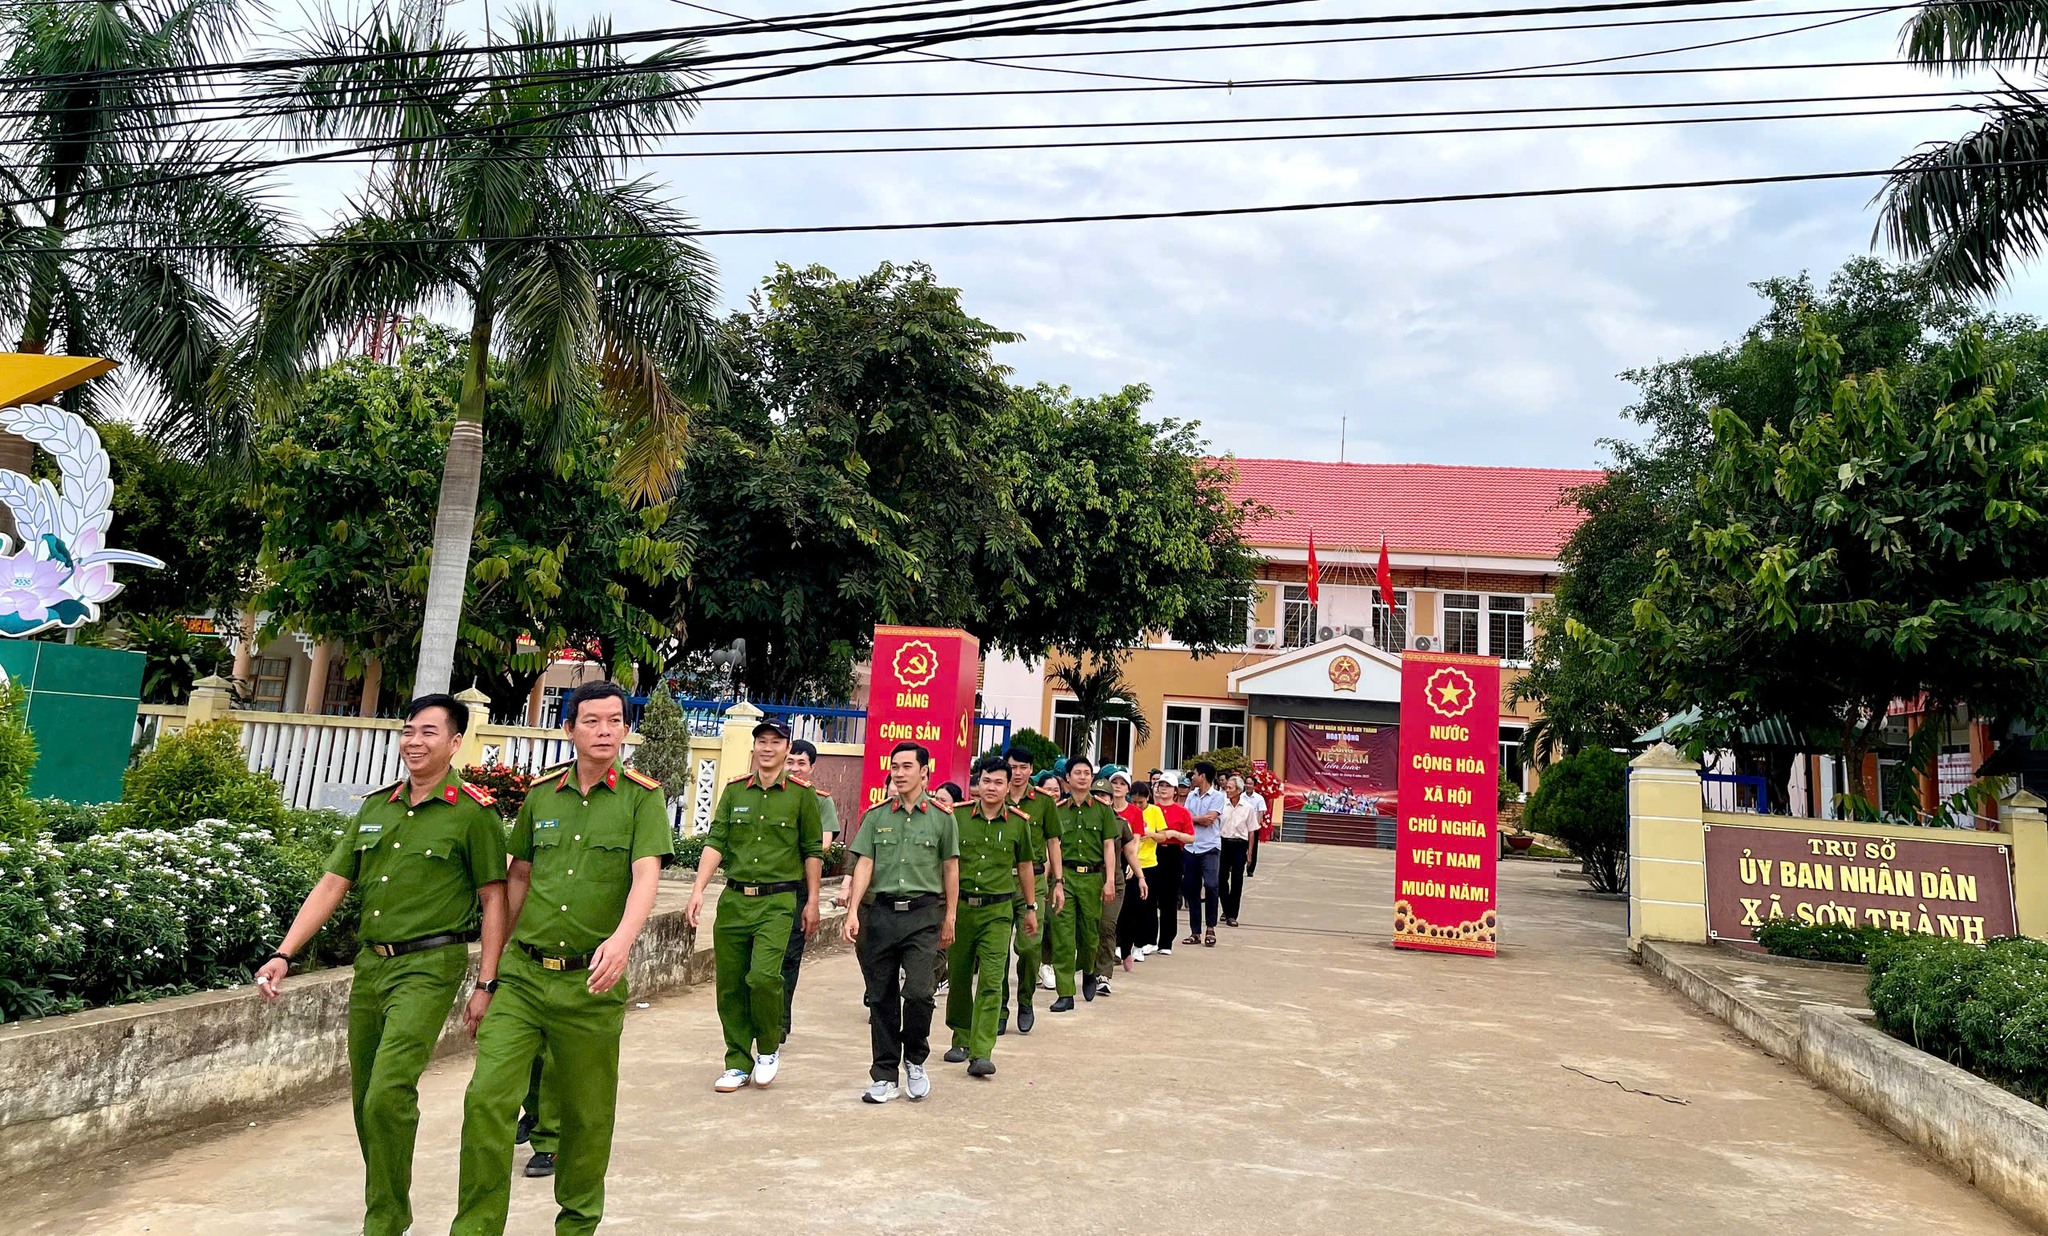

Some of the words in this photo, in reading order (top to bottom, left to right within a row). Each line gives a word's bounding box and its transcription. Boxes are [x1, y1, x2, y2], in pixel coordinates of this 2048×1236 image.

[896, 689, 929, 708] ĐẢNG
[880, 721, 913, 742] CỘNG
[915, 721, 941, 741] SẢN
[1429, 725, 1470, 742] NƯỚC
[1412, 754, 1452, 773] CỘNG
[1456, 758, 1485, 775] HÒA
[1423, 786, 1444, 803] XÃ
[1447, 787, 1472, 807] HỘI
[1408, 814, 1438, 833] CHỦ
[1441, 819, 1486, 838] NGHĨA
[1412, 849, 1443, 869] VIỆT
[1446, 852, 1481, 870] NAM
[1807, 838, 1858, 862] TRỤ
[1865, 837, 1897, 861] SỞ
[1739, 848, 1773, 885] ỦY
[1779, 861, 1834, 891] BAN
[1840, 861, 1915, 898] NHÂN
[1921, 866, 1978, 902] DÂN
[1401, 880, 1446, 899] MUÔN
[1449, 882, 1489, 903] NĂM!
[1739, 893, 1784, 926] XÃ
[1796, 900, 1857, 928] SƠN
[1864, 903, 1986, 945] THÀNH
